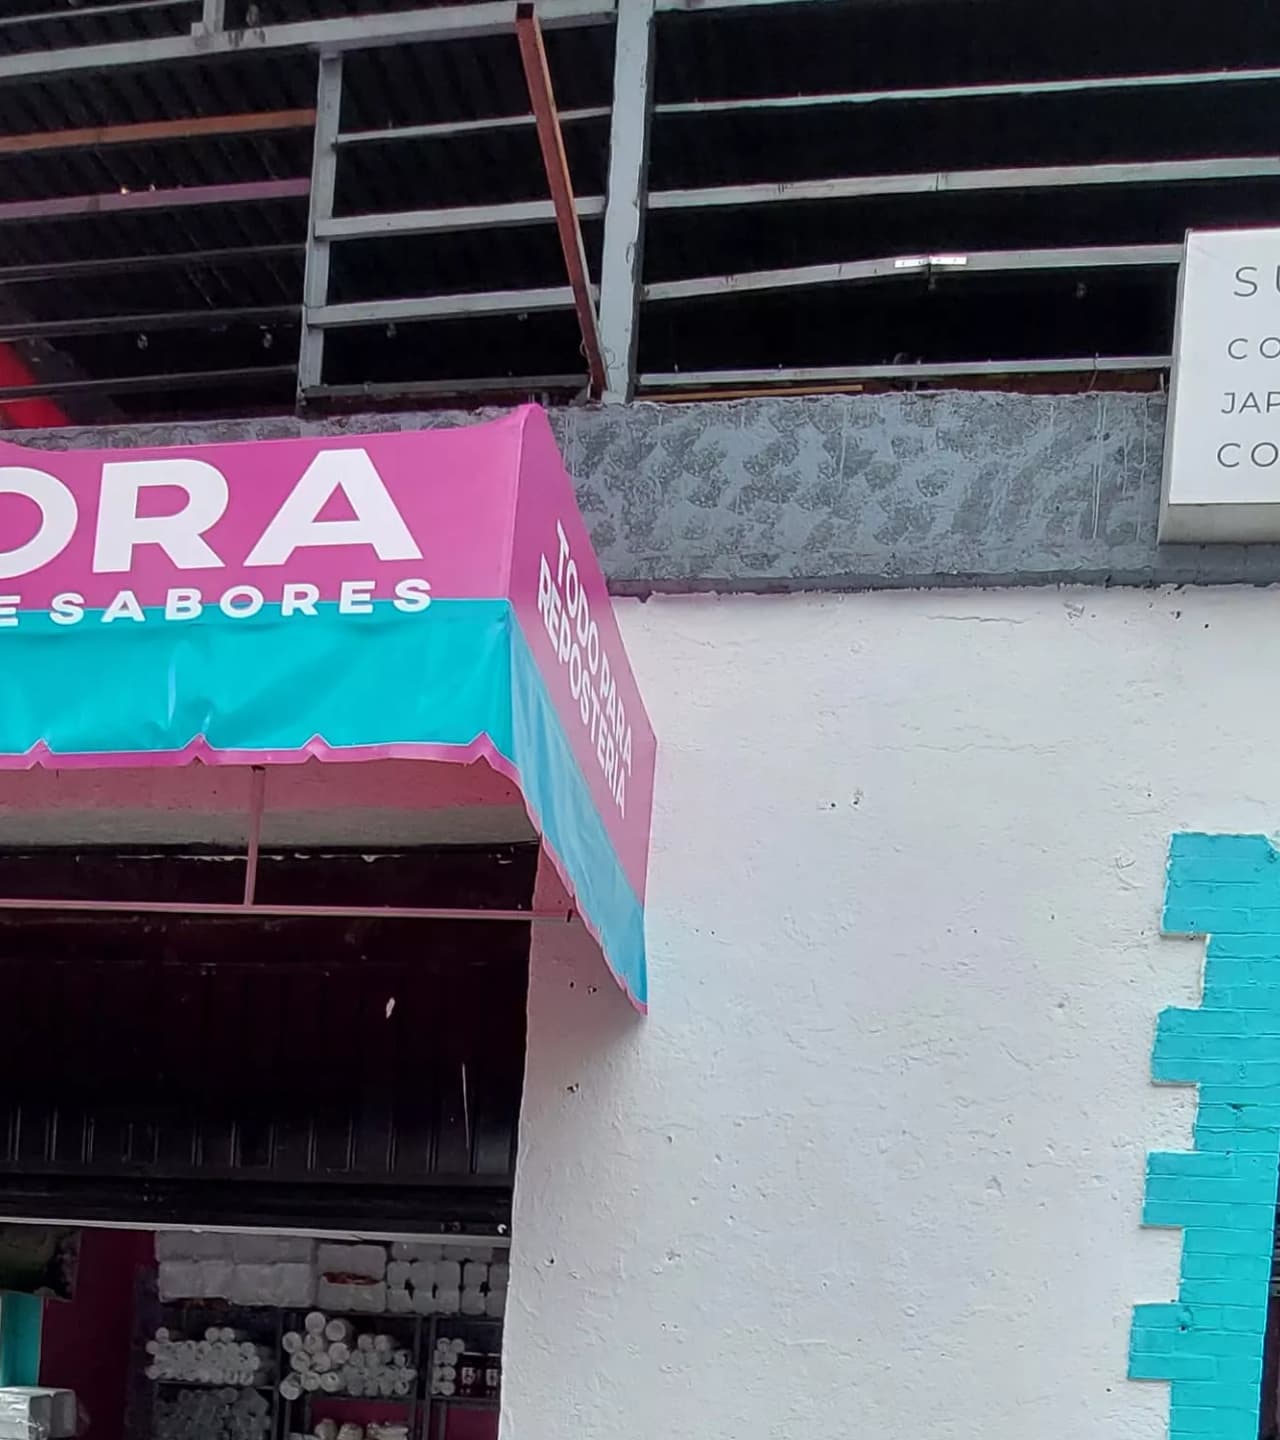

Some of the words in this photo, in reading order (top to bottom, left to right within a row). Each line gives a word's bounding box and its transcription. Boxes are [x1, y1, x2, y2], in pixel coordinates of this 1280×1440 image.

[49, 577, 432, 627] SABORES
[537, 552, 626, 820] REPOSTERIA
[555, 518, 600, 676] TODO
[600, 651, 632, 778] PARA
